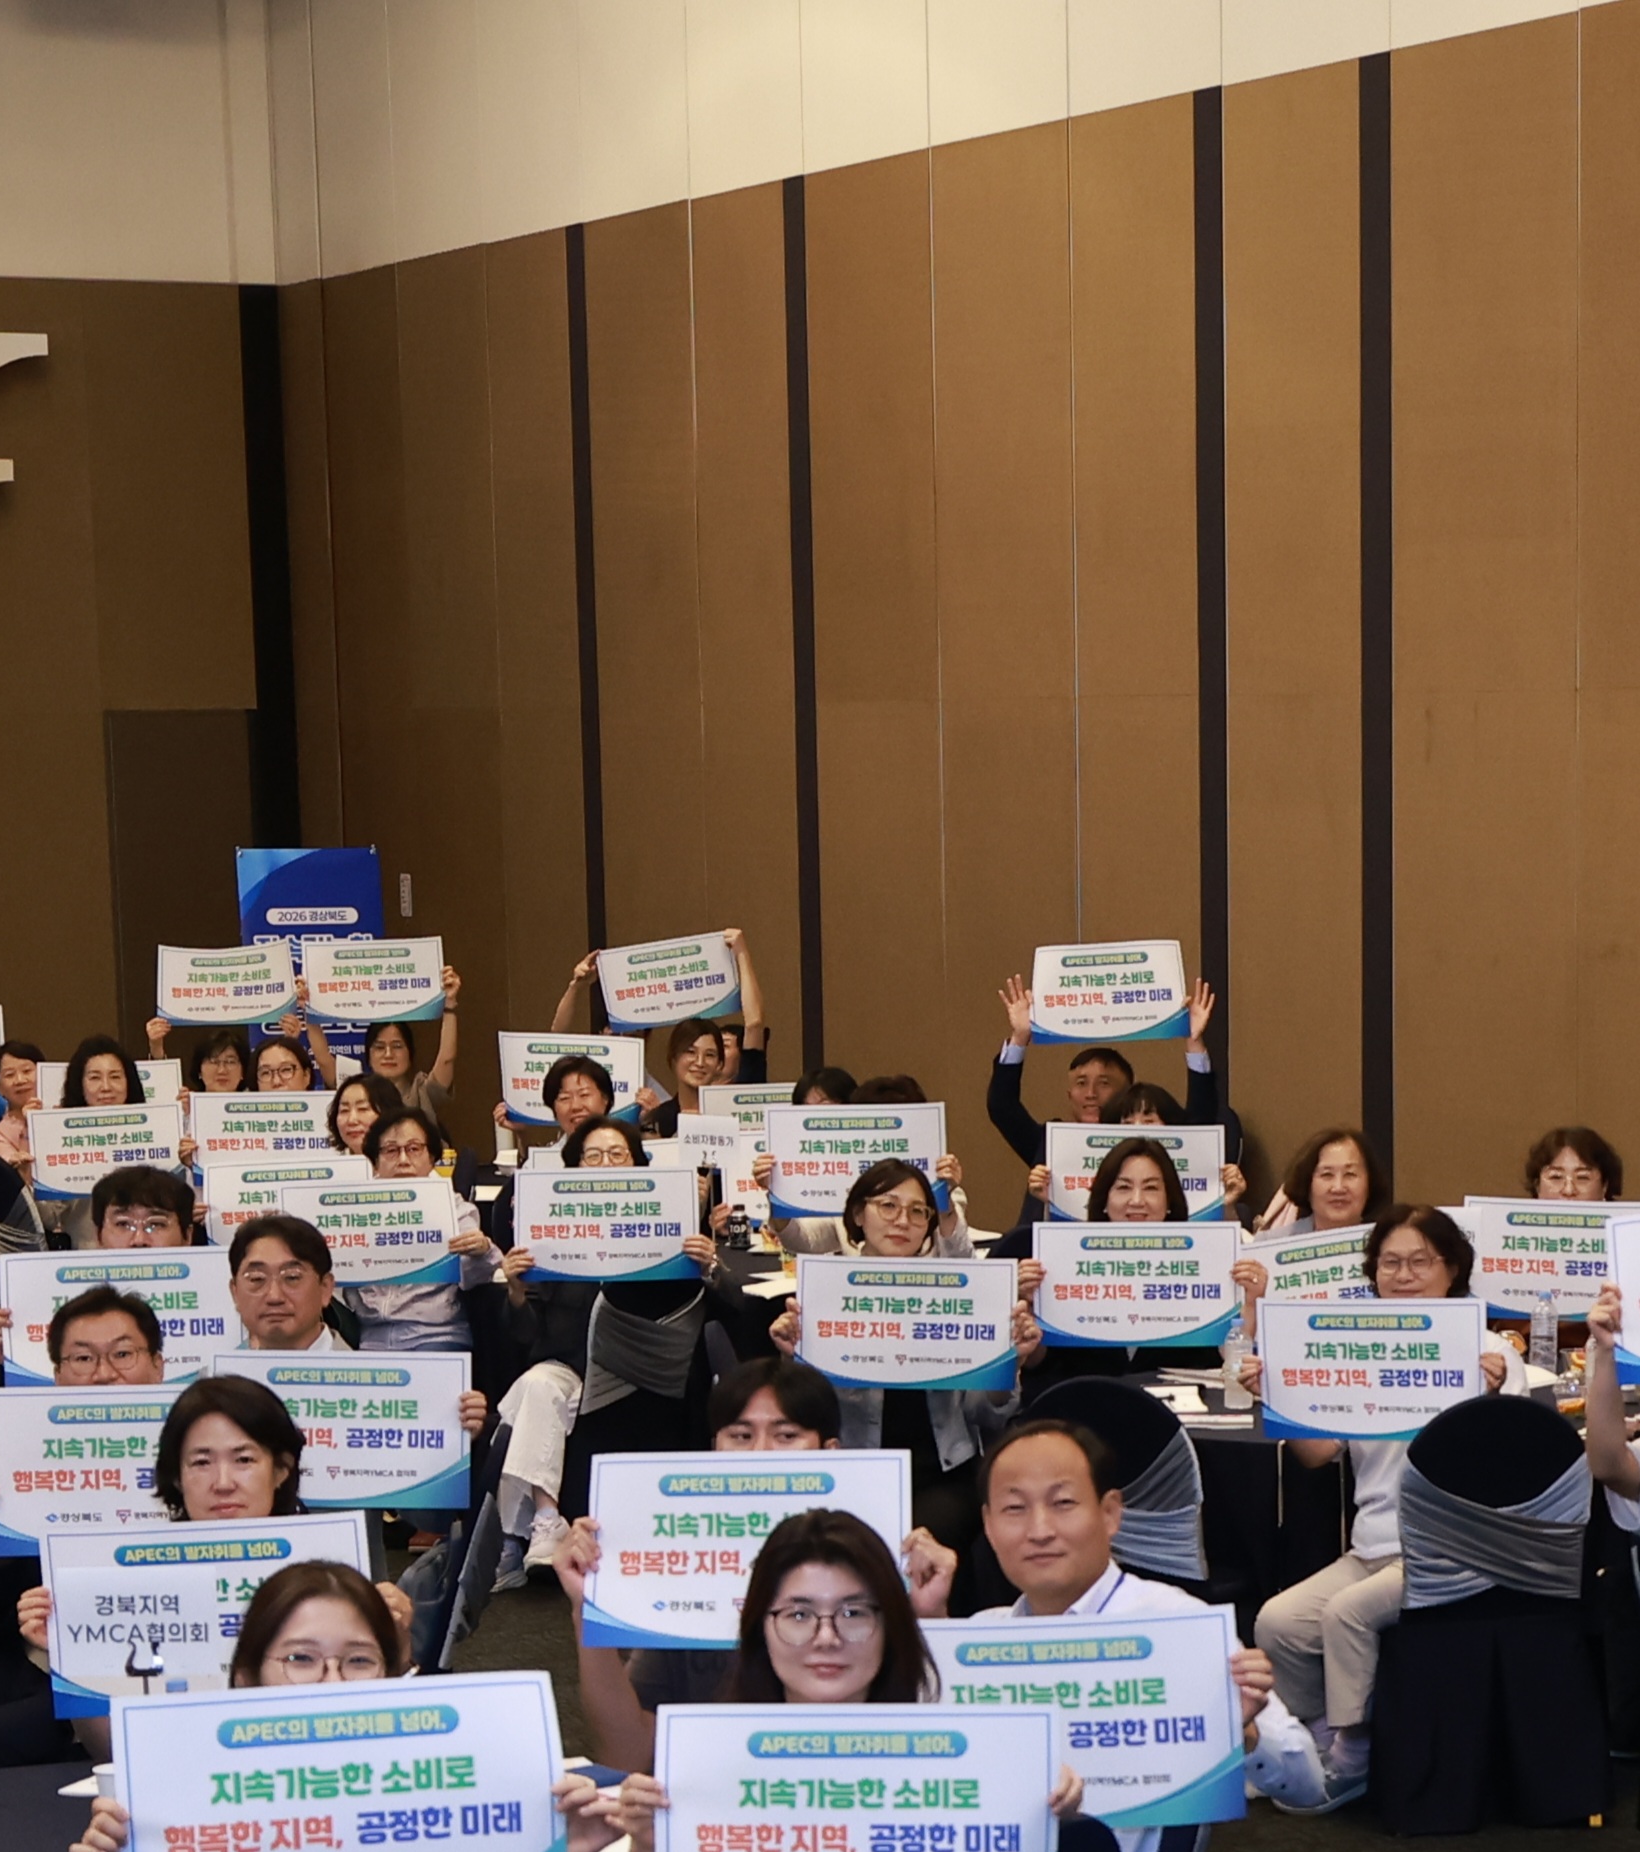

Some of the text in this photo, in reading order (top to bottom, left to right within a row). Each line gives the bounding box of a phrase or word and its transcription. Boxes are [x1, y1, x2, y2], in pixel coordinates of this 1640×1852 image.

[277, 910, 348, 922] 2026 경상북도
[548, 1201, 662, 1218] 지속가능한 소비로
[529, 1222, 681, 1239] 행복한 지역, 공정한 미래
[841, 1296, 974, 1316] 지속가능한 소비로
[816, 1319, 995, 1341] 행복한 지역, 공정한 미래
[94, 1594, 180, 1616] 경북지역
[68, 1622, 209, 1643] YMCA협의회
